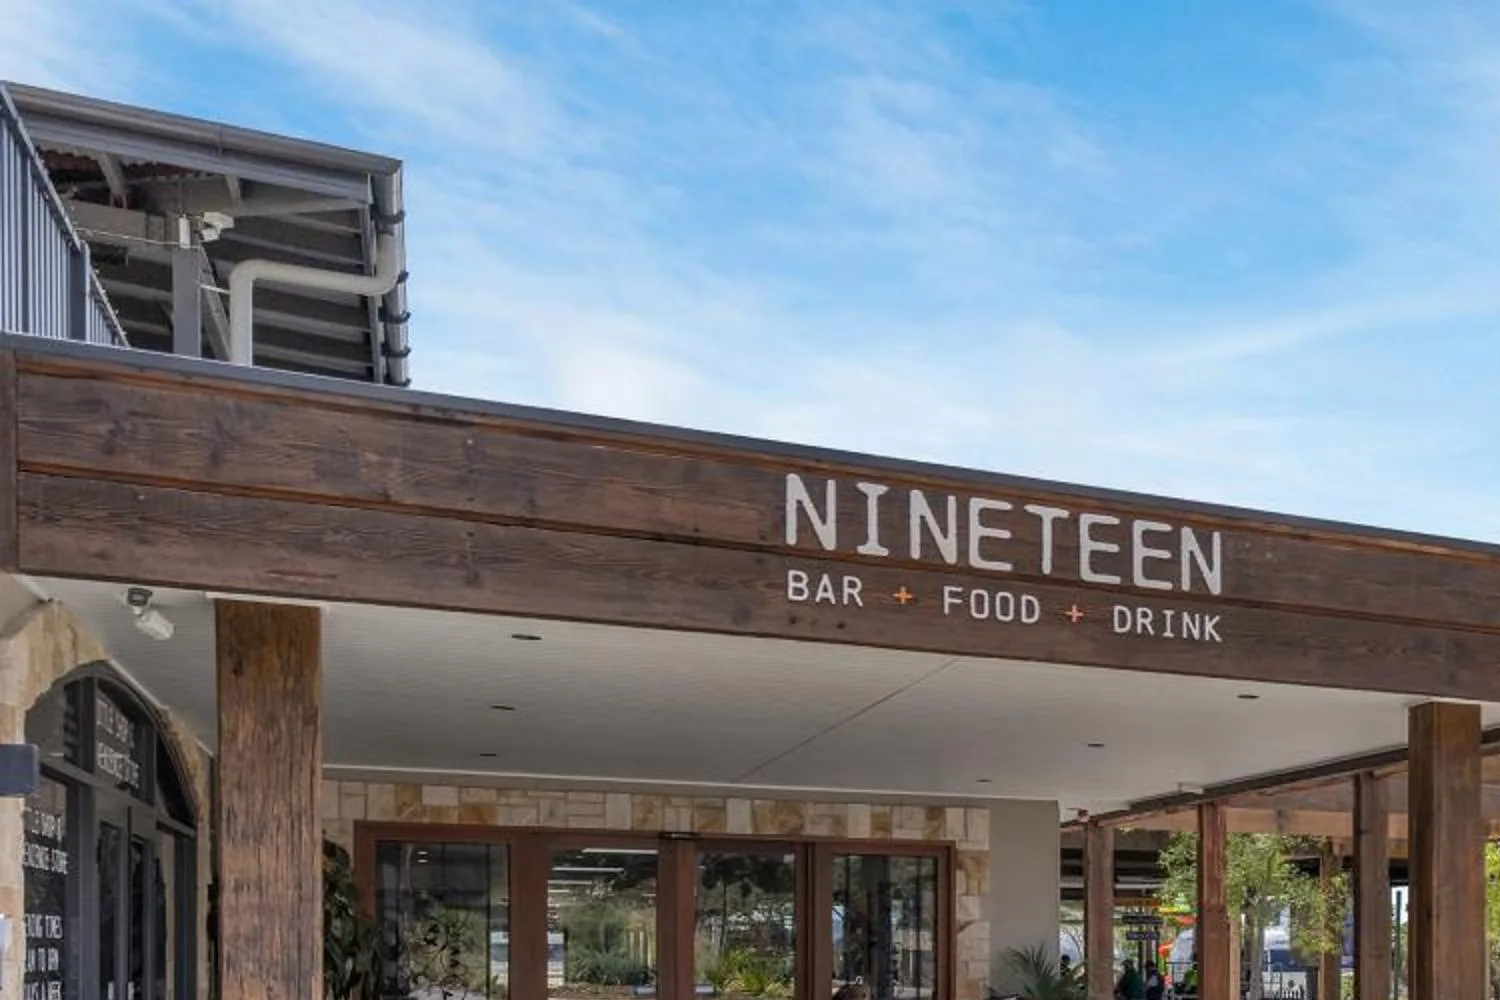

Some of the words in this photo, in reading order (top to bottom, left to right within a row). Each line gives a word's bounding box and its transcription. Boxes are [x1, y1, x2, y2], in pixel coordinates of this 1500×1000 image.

[785, 472, 1222, 596] NINETEEN
[787, 569, 863, 608] BAR
[942, 586, 1041, 624] FOOD
[1112, 605, 1223, 643] DRINK
